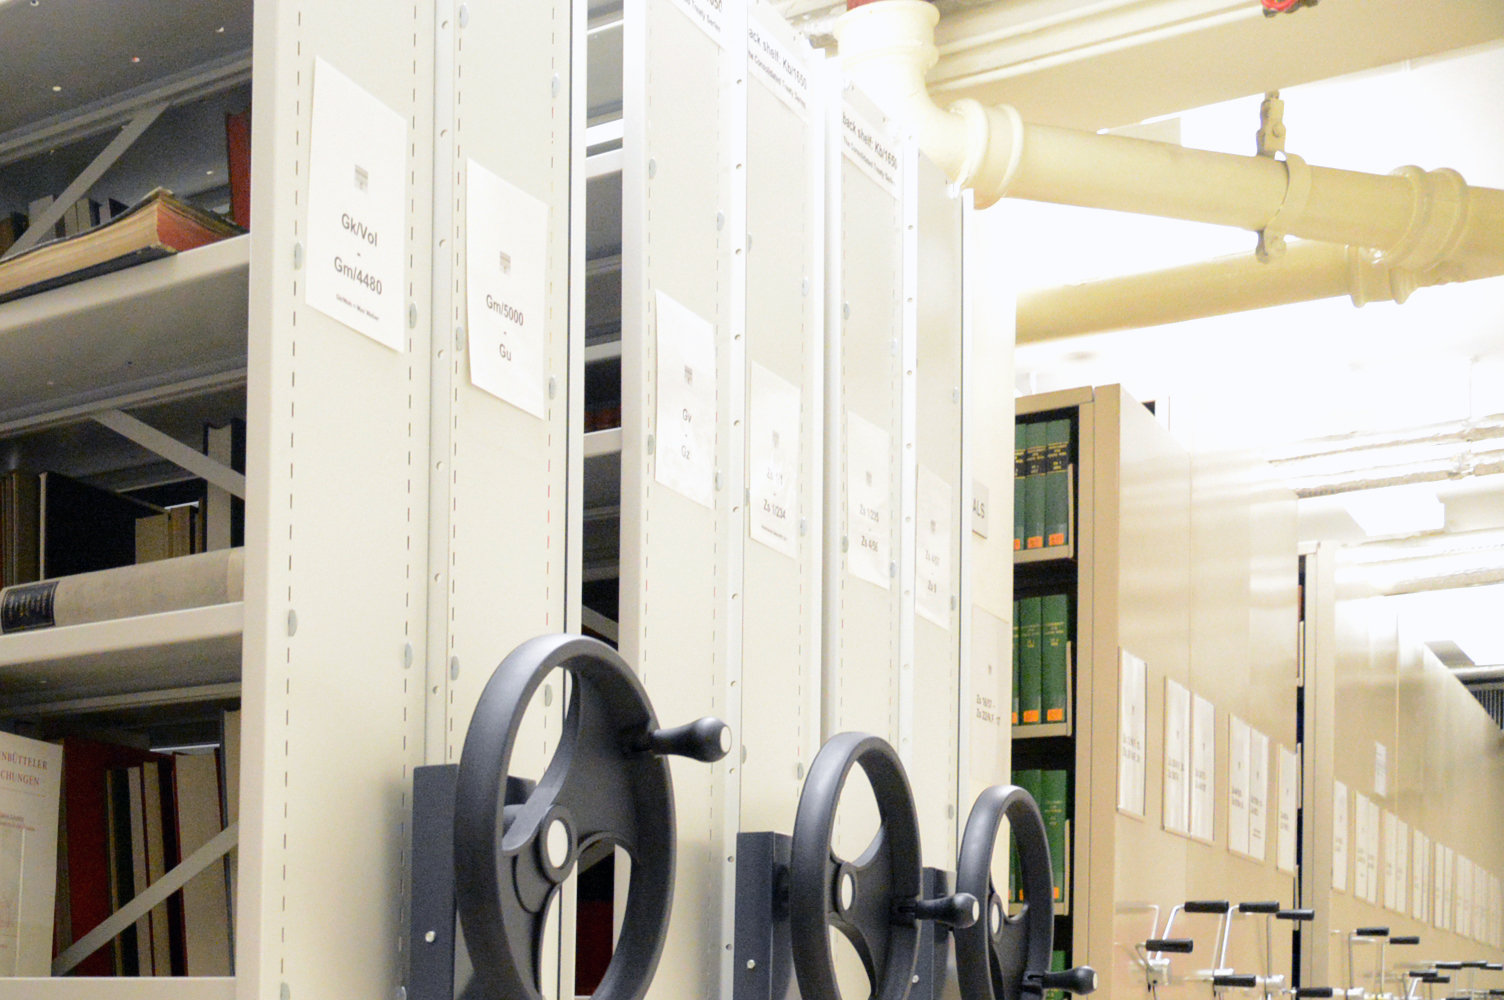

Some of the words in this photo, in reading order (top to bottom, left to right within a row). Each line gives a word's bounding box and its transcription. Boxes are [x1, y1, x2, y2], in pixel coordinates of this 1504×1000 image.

[341, 212, 378, 247] Gk/Vol
[334, 256, 383, 296] Gm/4480
[486, 294, 524, 326] Gm/5000
[498, 343, 512, 362] Gu
[682, 408, 692, 423] Gv
